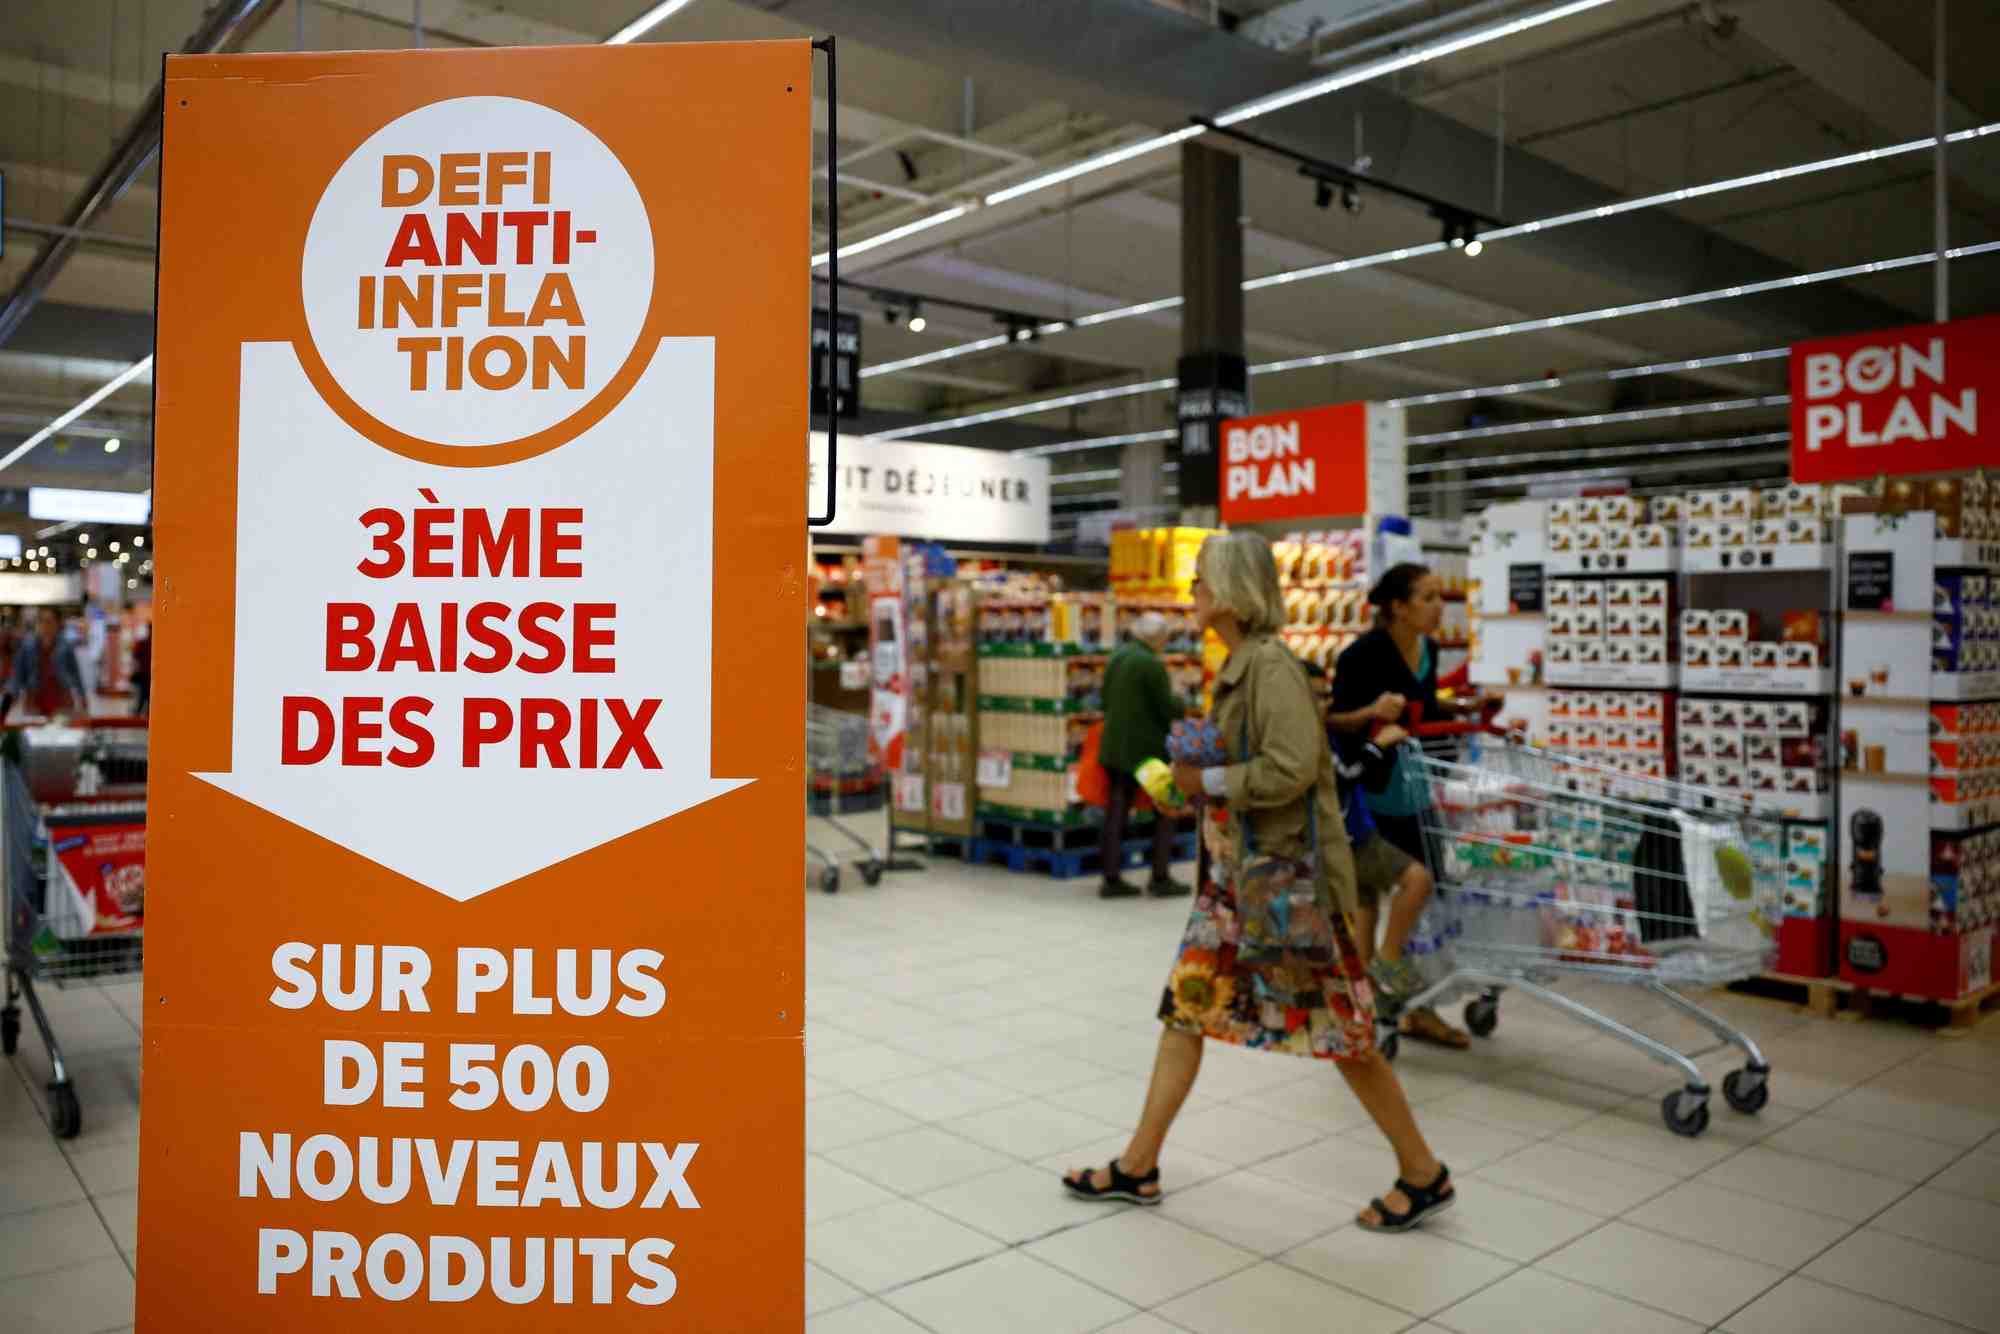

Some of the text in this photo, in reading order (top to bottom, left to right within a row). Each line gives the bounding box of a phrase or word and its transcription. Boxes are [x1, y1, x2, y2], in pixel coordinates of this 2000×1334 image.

[382, 152, 551, 207] DEFI
[385, 211, 597, 267] ANTI-
[358, 273, 584, 329] INFLA
[398, 336, 585, 391] TION
[1805, 338, 1945, 399] BON
[1227, 421, 1299, 462] BON
[1806, 389, 1977, 450] PLAN
[1227, 458, 1315, 500] PLAN
[357, 488, 583, 578] 3ÈME
[326, 602, 616, 674] BAISSE
[282, 696, 662, 769] DES PRIX
[270, 942, 666, 1017] SUR PLUS
[324, 1040, 609, 1112] DE 500
[239, 1132, 700, 1209] NOUVEAUX
[258, 1228, 677, 1305] PRODUITS
